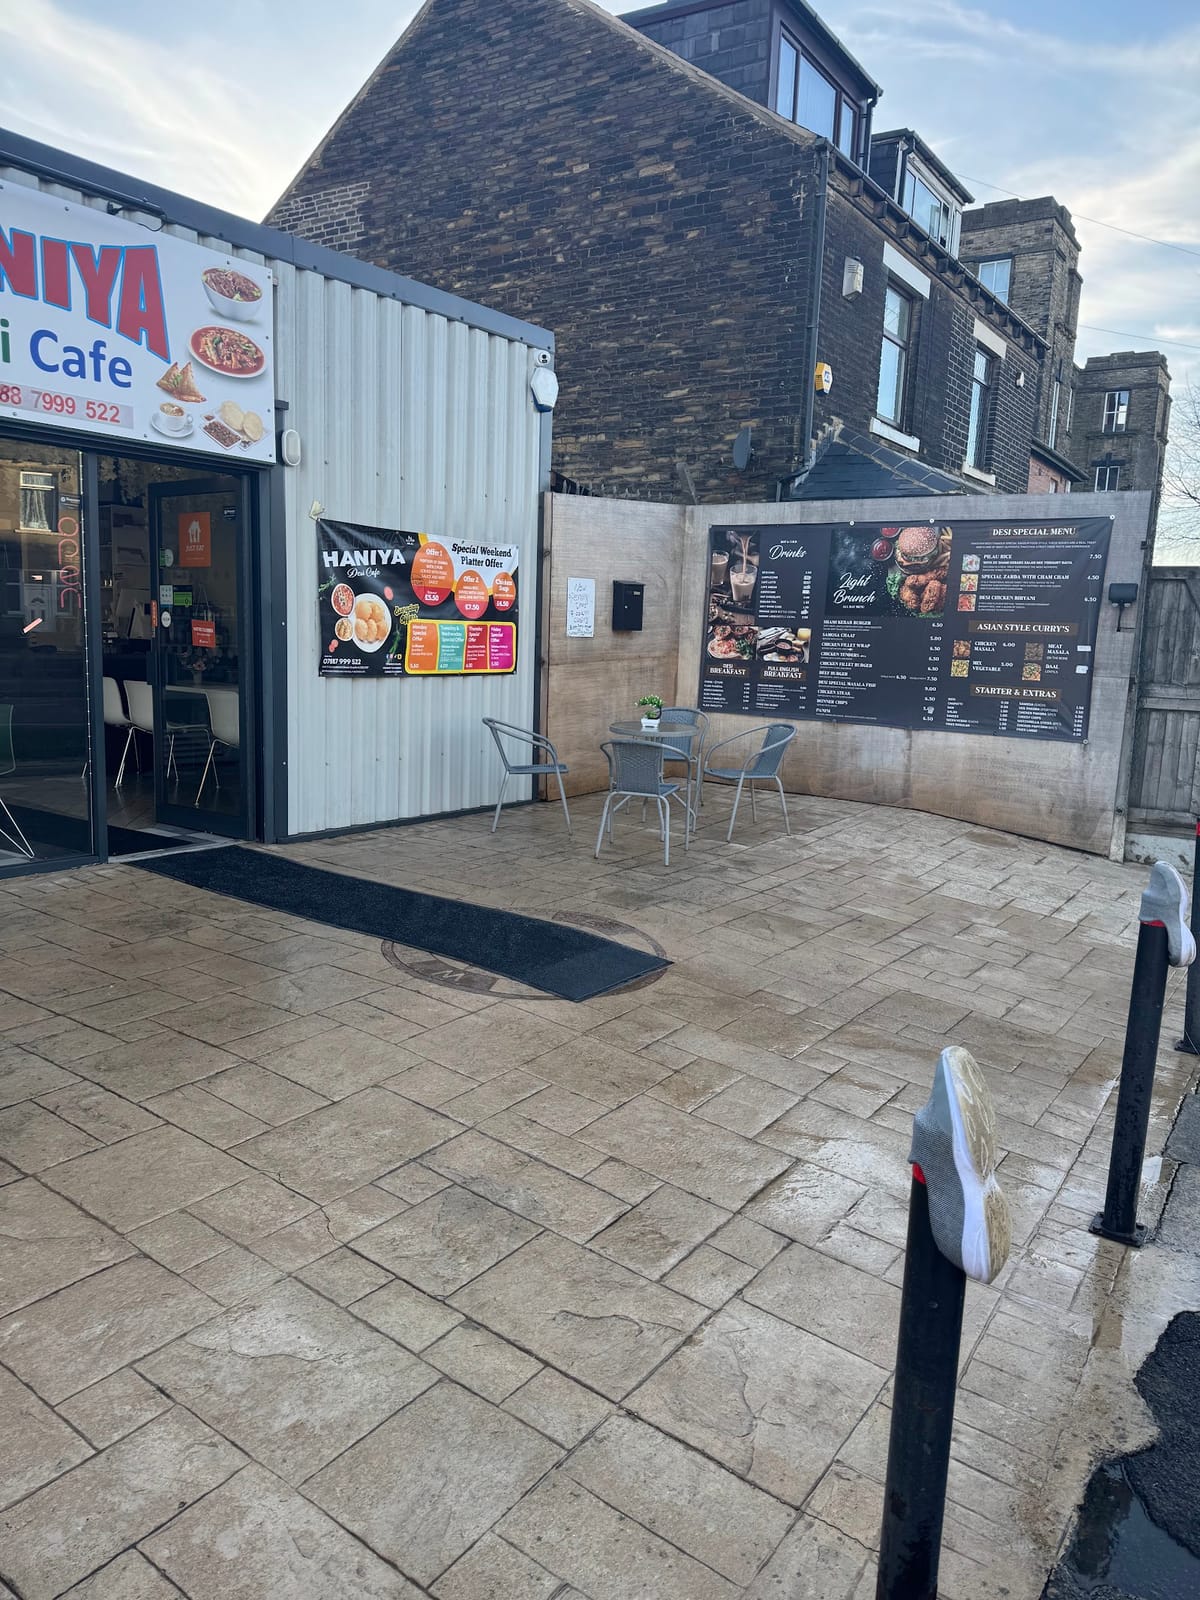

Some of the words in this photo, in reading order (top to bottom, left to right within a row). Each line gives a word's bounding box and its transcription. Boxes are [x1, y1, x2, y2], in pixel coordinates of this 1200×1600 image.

[30, 329, 133, 388] Cafe
[31, 390, 76, 415] 7999
[86, 401, 121, 423] 522
[993, 528, 1010, 536] DESI
[1013, 528, 1049, 536] SPECIAL
[426, 548, 440, 556] Offer
[452, 543, 478, 554] Special
[480, 546, 512, 557] Weekend
[769, 545, 807, 560] Drinks
[322, 549, 406, 568] HANIYA
[461, 556, 483, 566] Platter
[485, 559, 503, 568] Offer
[366, 566, 380, 578] Cafe
[840, 572, 872, 590] Light
[833, 589, 876, 604] Brunch
[1033, 625, 1070, 633] CURRY'S
[764, 671, 802, 679] BREAKFAST
[975, 687, 1013, 695] STARTER
[1023, 690, 1057, 698] EXTRAS
